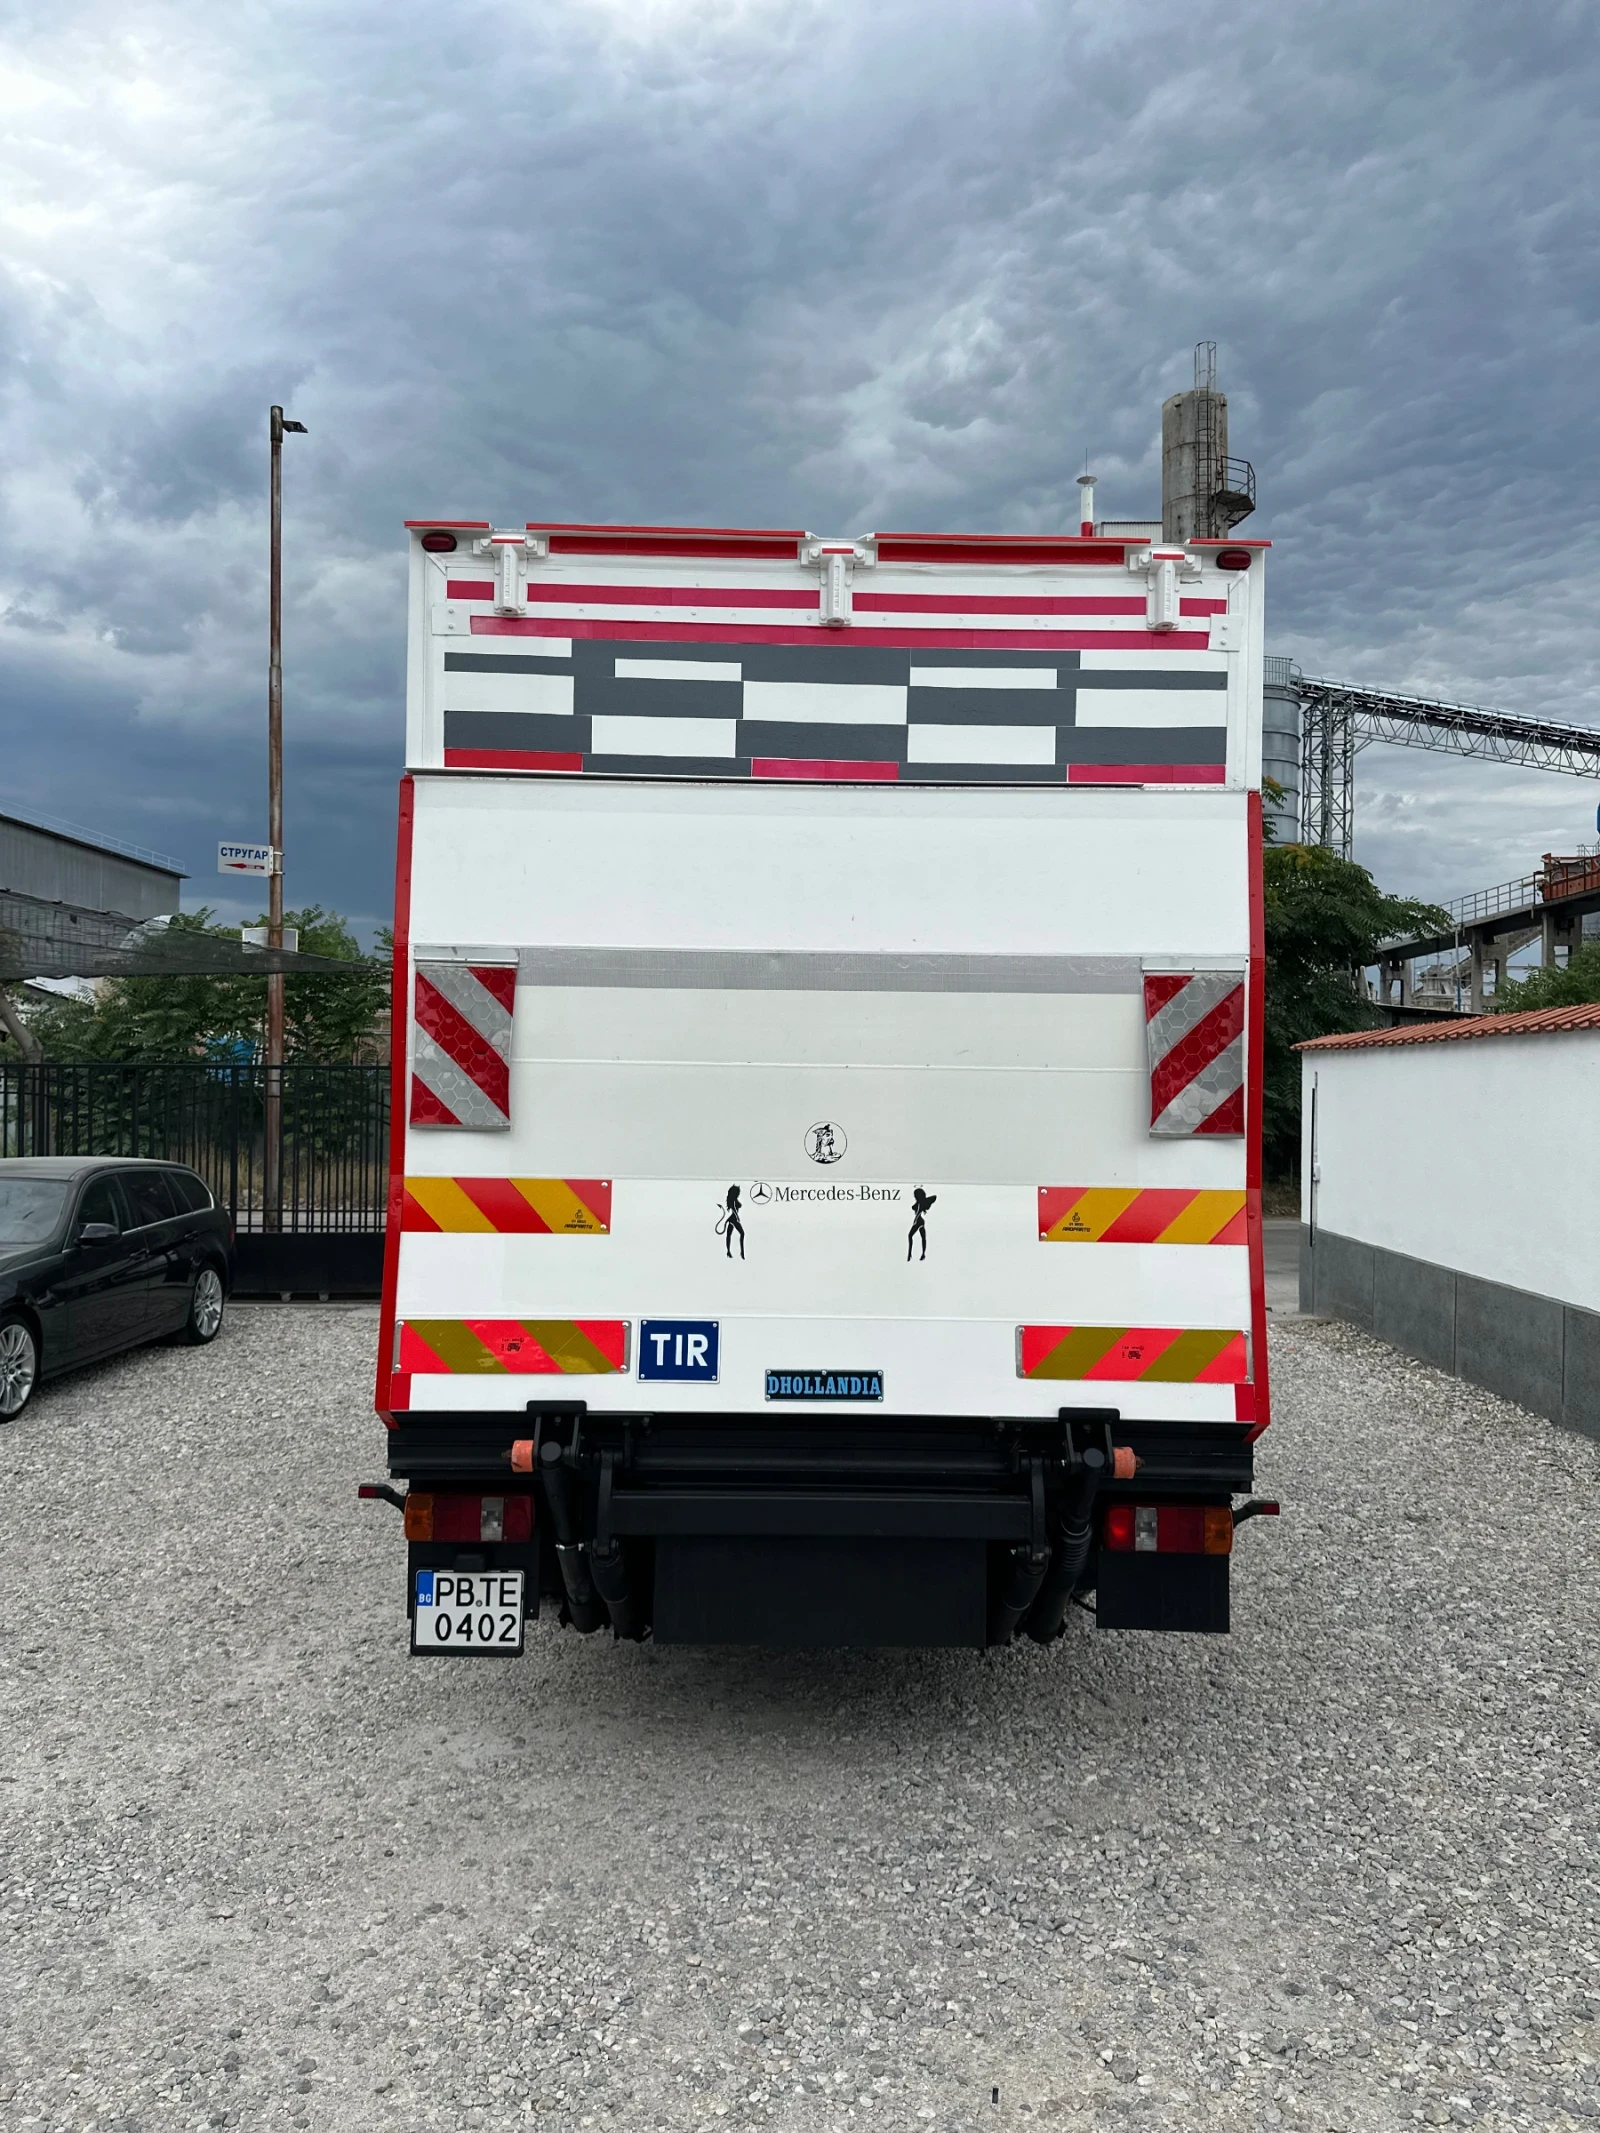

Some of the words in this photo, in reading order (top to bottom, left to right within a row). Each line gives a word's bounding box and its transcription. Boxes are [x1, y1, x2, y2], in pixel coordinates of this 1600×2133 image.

[220, 847, 269, 860] СТРУГАР
[775, 1185, 901, 1203] Mercedes-Benz
[650, 1333, 709, 1367] TIR
[767, 1376, 882, 1395] DHOLLANDIA
[418, 1593, 432, 1603] BG
[435, 1613, 517, 1642] 0402
